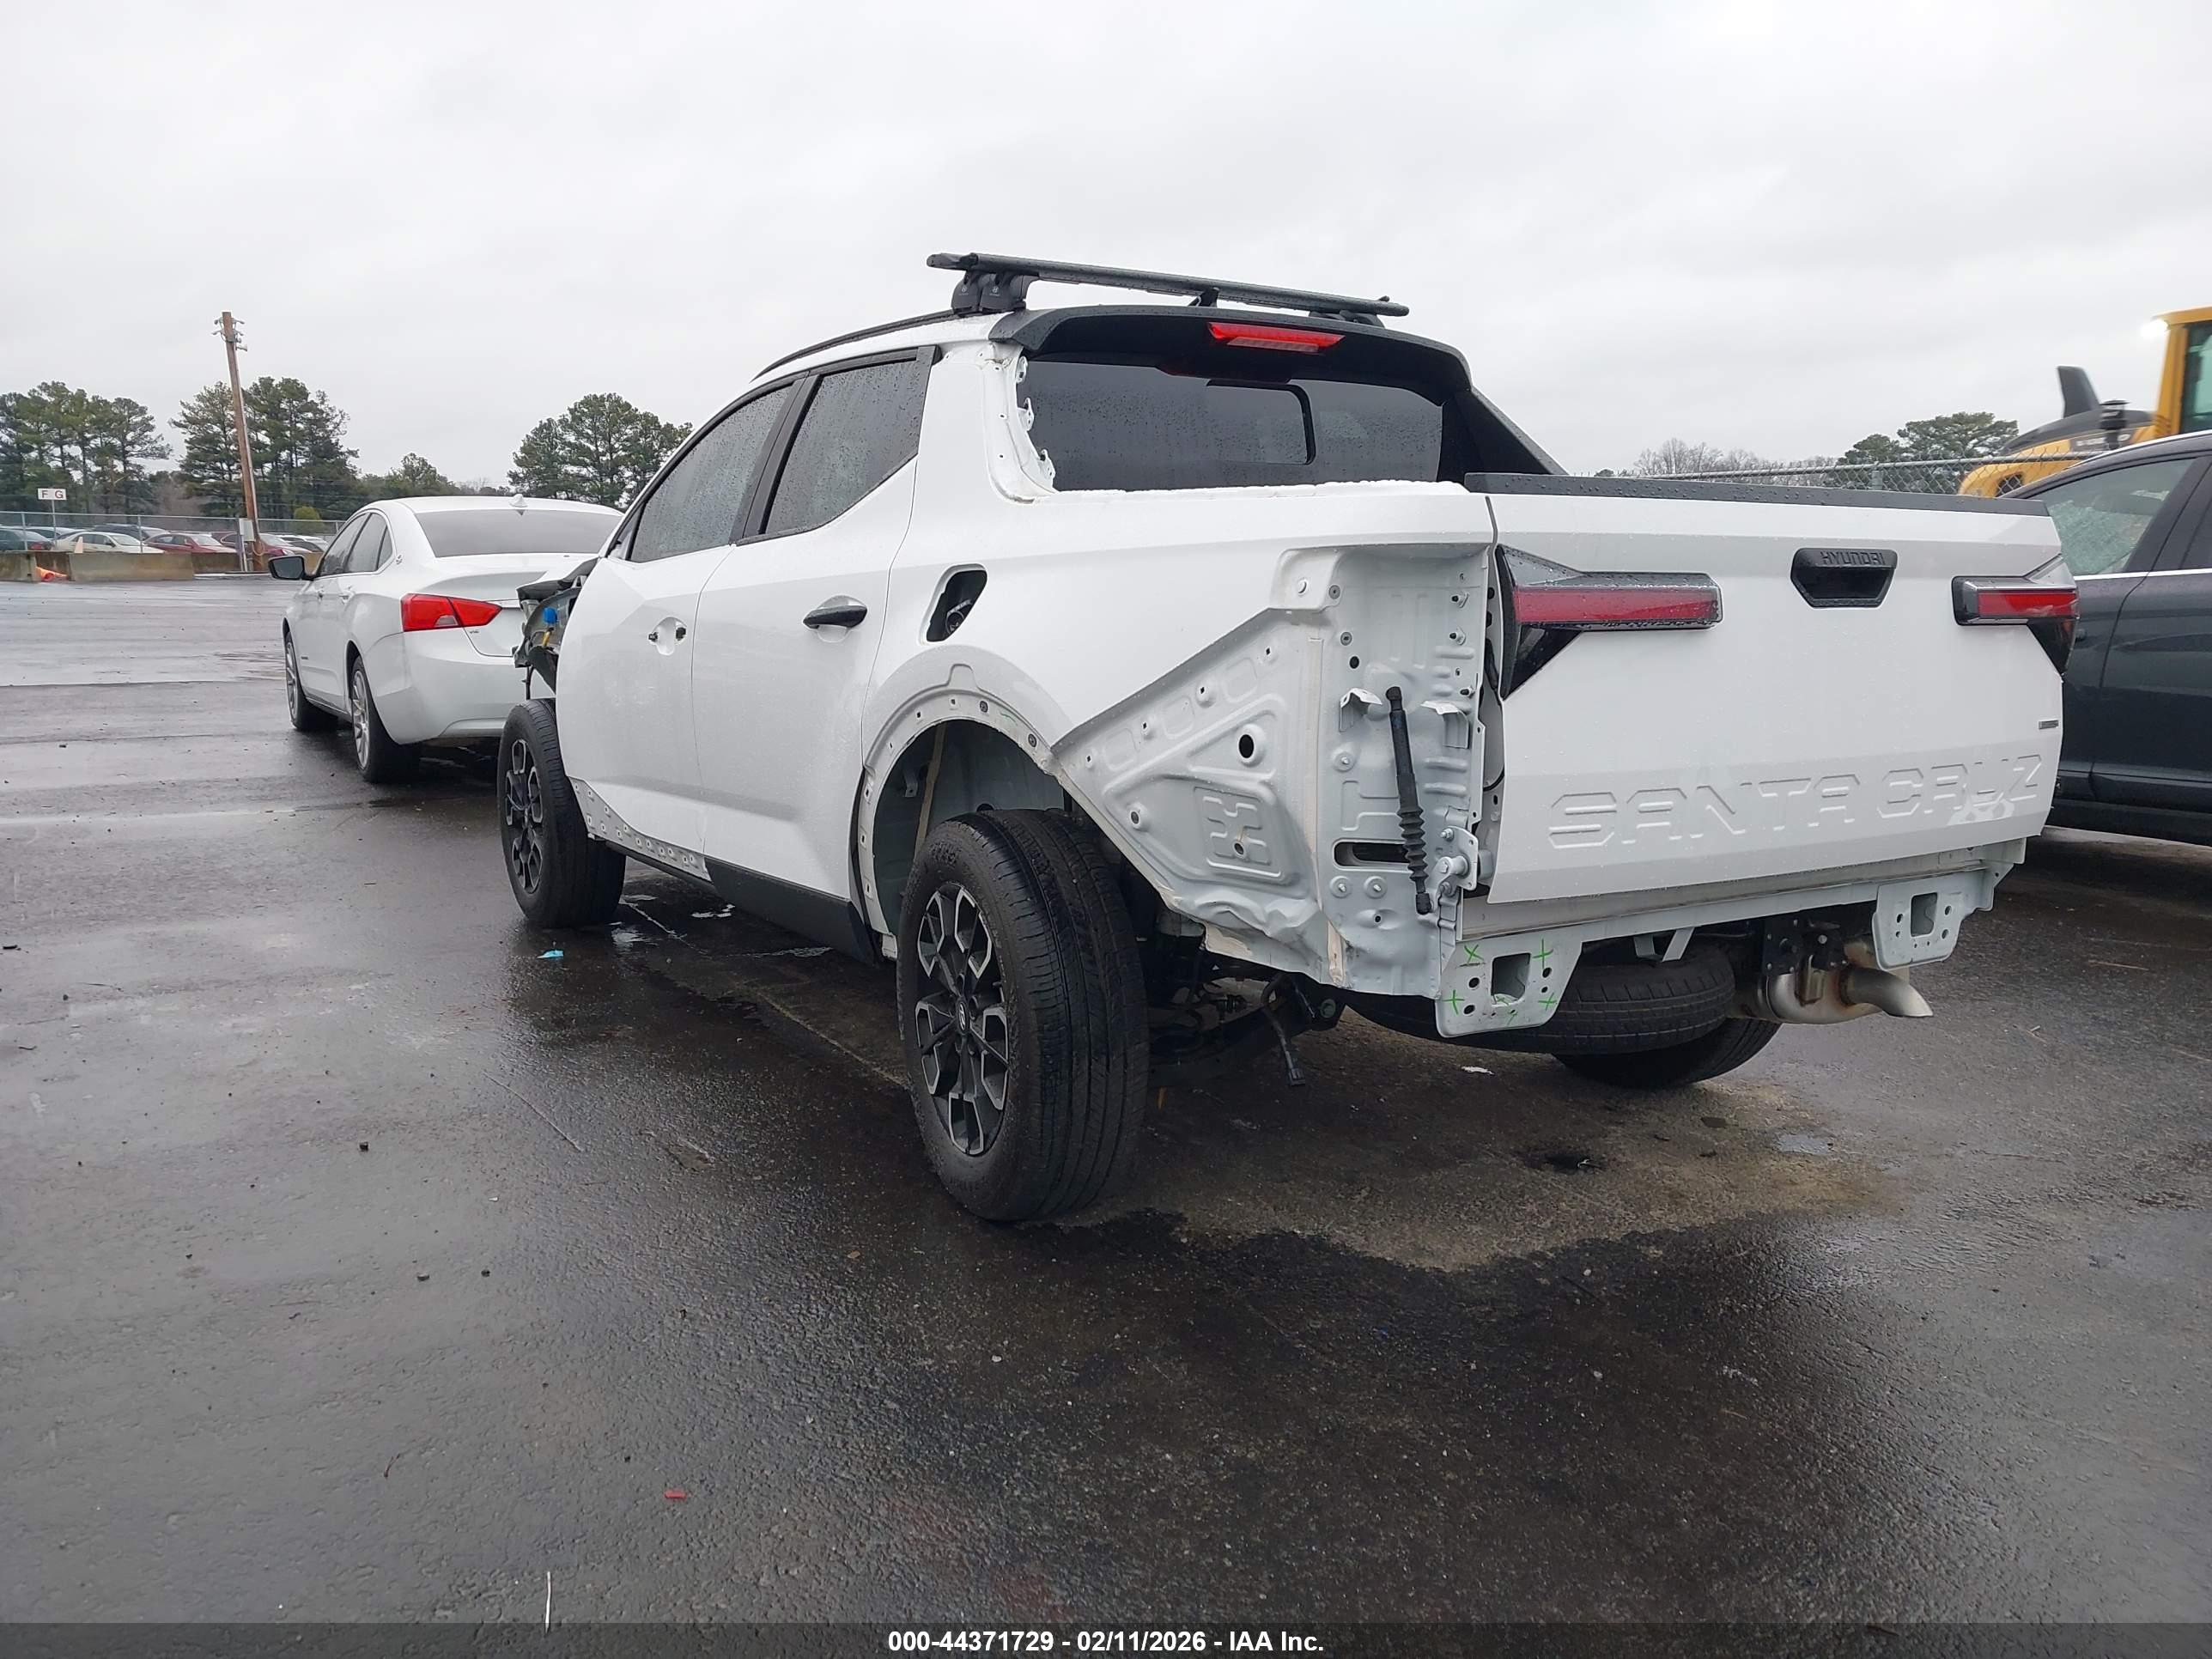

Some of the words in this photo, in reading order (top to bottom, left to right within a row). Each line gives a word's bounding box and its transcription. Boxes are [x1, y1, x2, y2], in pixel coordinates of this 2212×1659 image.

[41, 489, 49, 499] F
[54, 489, 64, 499] G
[1820, 551, 1887, 566] HYUNDAI
[1547, 774, 1861, 849] SANTA
[1875, 753, 2042, 818] CRUZ
